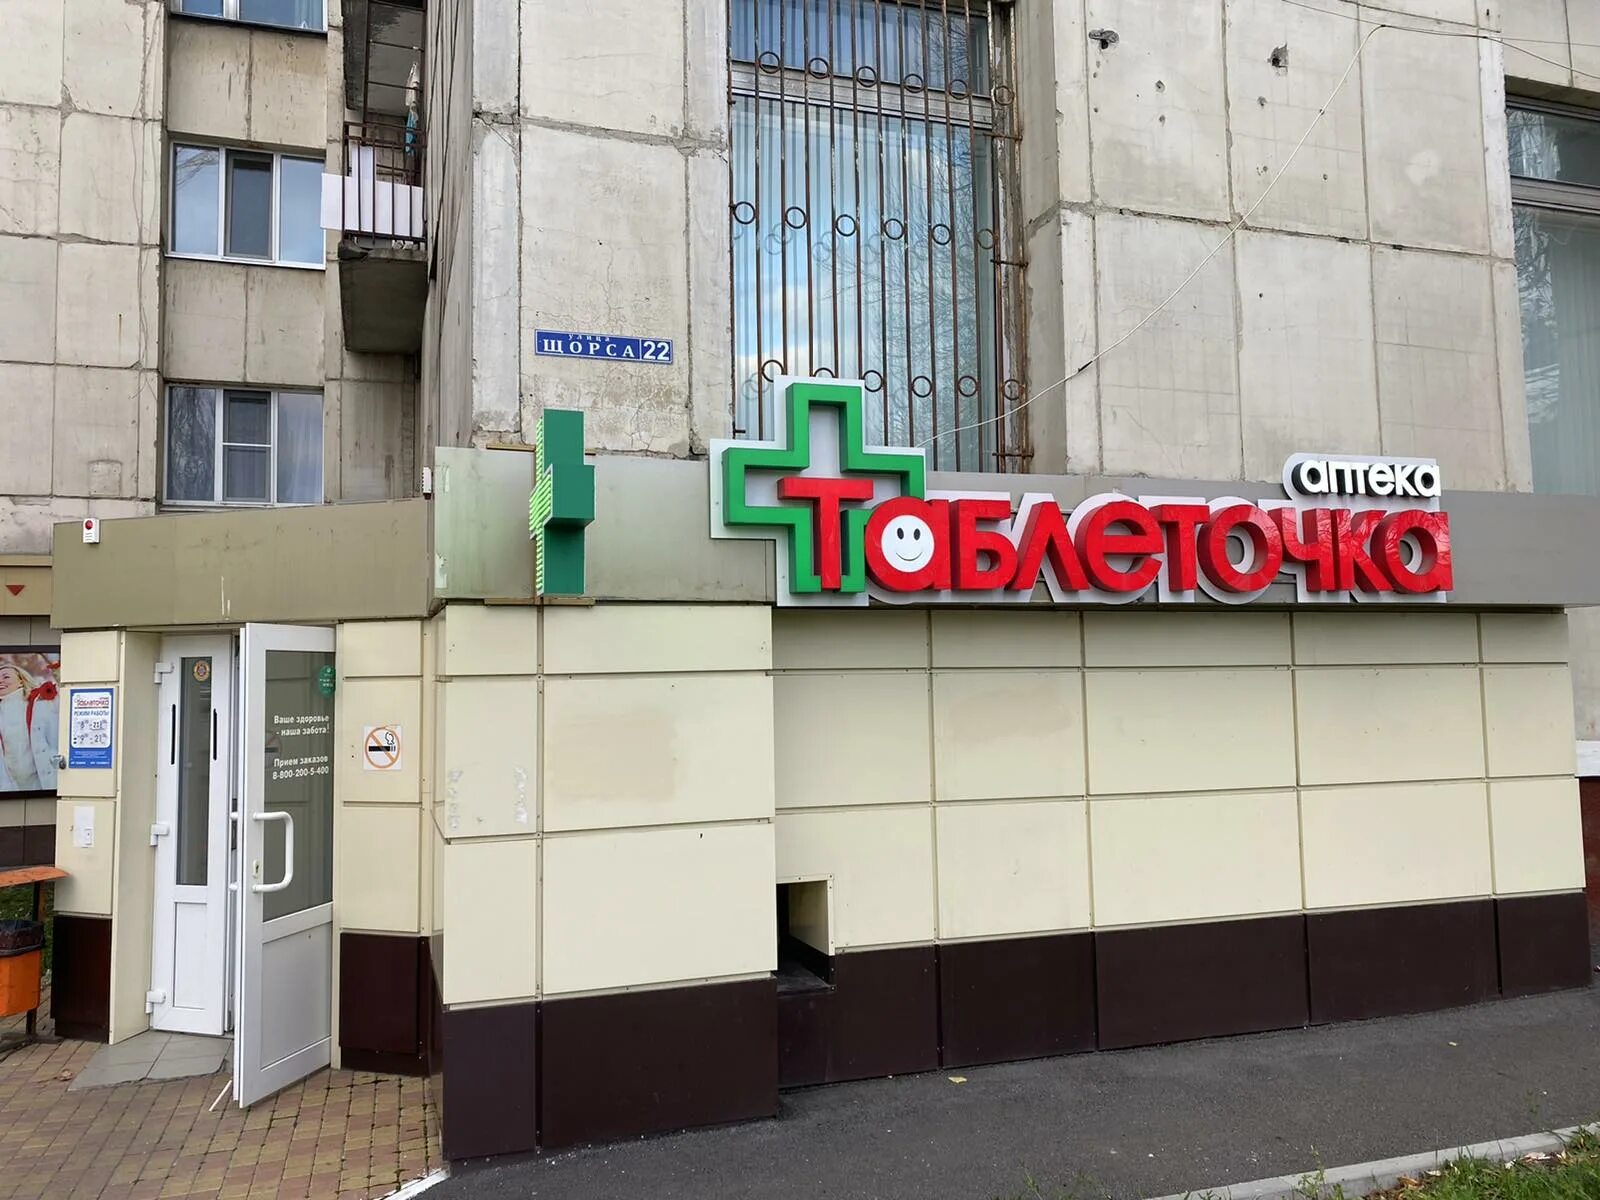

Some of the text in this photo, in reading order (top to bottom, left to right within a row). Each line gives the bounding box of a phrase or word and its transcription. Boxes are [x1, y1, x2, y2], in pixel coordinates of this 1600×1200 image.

[568, 333, 611, 342] улица
[542, 338, 670, 361] ЩОРСА 22
[1293, 459, 1442, 498] аптека
[777, 476, 1454, 595] Таблеточка
[274, 715, 330, 724] Ваше здоровье
[302, 723, 330, 735] забота!
[274, 756, 329, 768] Прием заказов
[272, 766, 330, 780] 8-800-200-5-400
